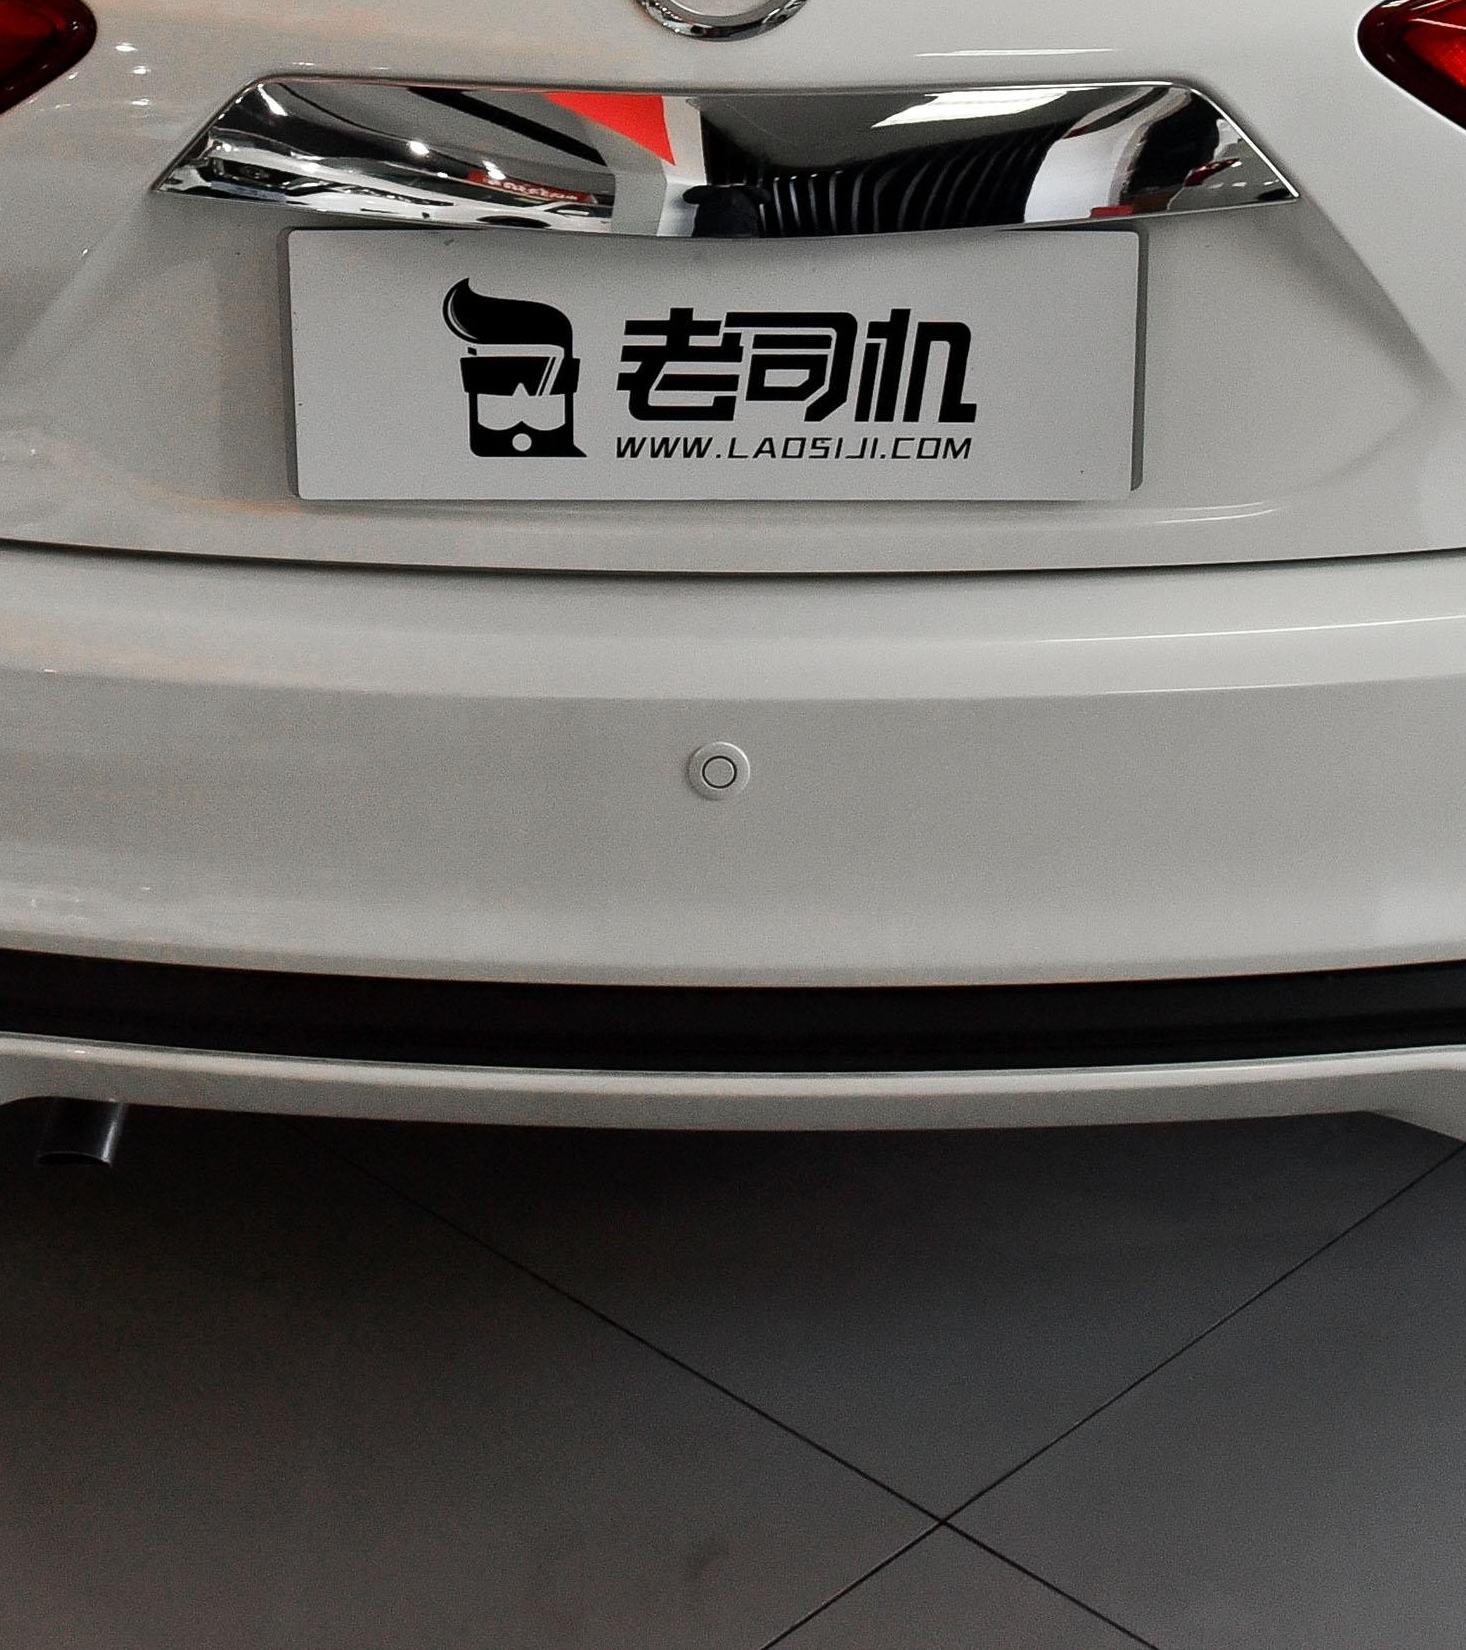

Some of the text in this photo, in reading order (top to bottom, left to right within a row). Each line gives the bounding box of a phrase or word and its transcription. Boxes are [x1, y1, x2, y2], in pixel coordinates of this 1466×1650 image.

[616, 307, 978, 423] 老司机
[615, 436, 973, 460] WWW.LAOSIJI.COM
